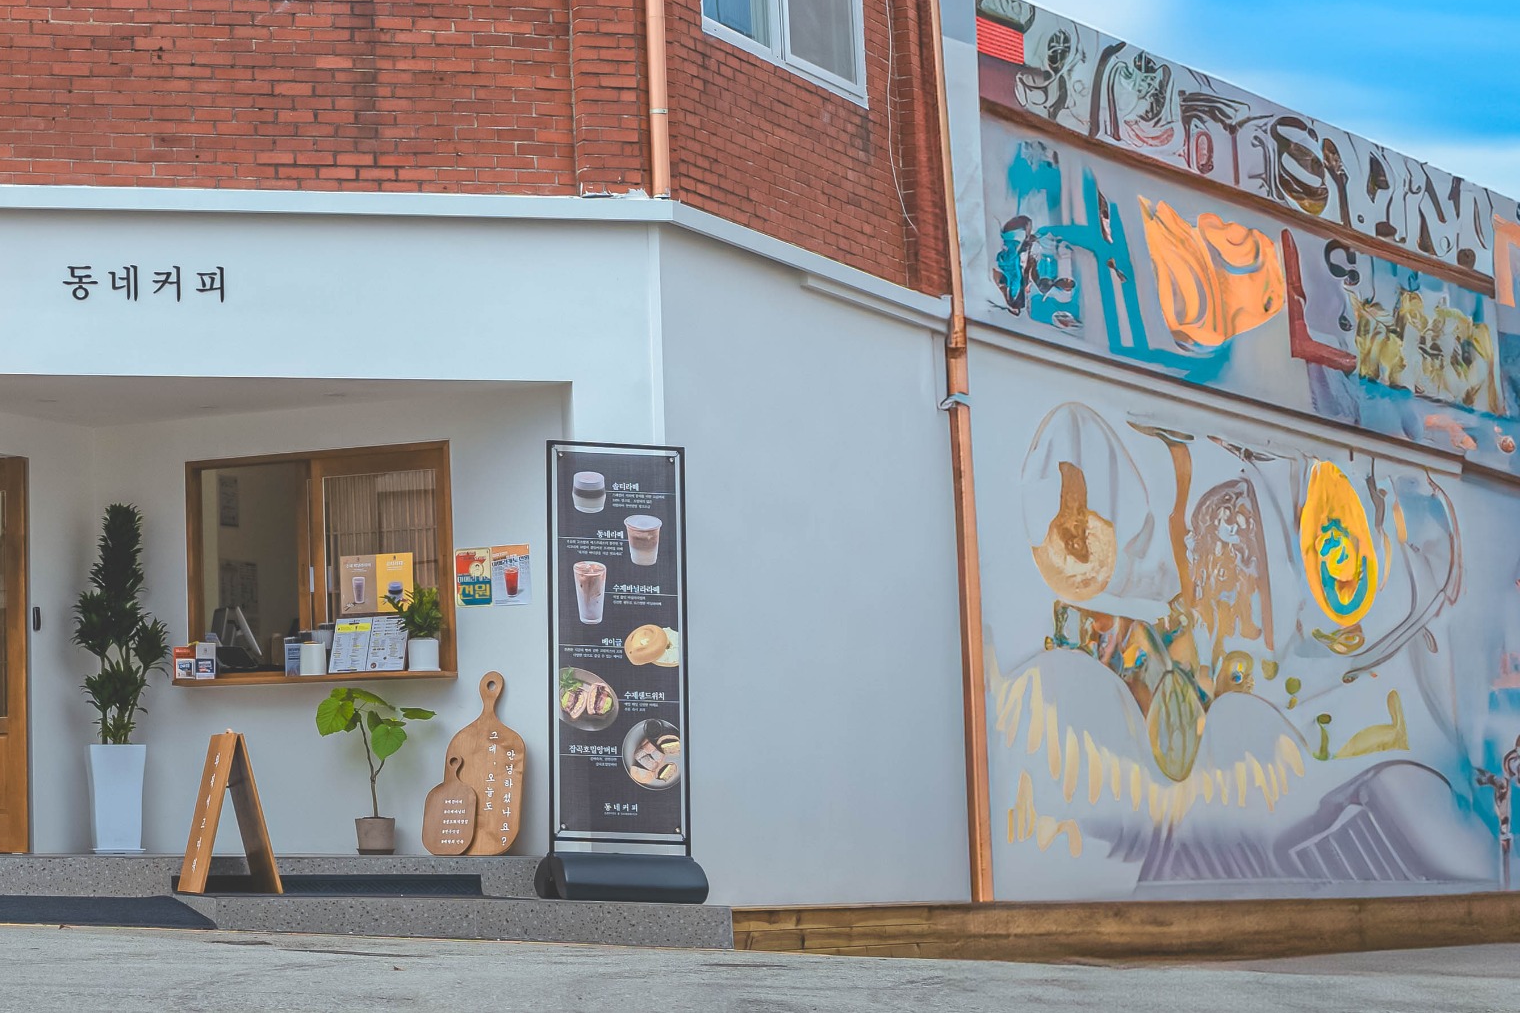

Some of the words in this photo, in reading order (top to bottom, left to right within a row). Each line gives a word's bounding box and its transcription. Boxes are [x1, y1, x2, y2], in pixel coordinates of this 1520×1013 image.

[62, 264, 225, 303] 동네커피
[602, 638, 622, 647] 베이글
[484, 773, 495, 810] 오늘도
[500, 750, 516, 846] 안녕하셨나요?
[604, 802, 638, 812] 동네커피
